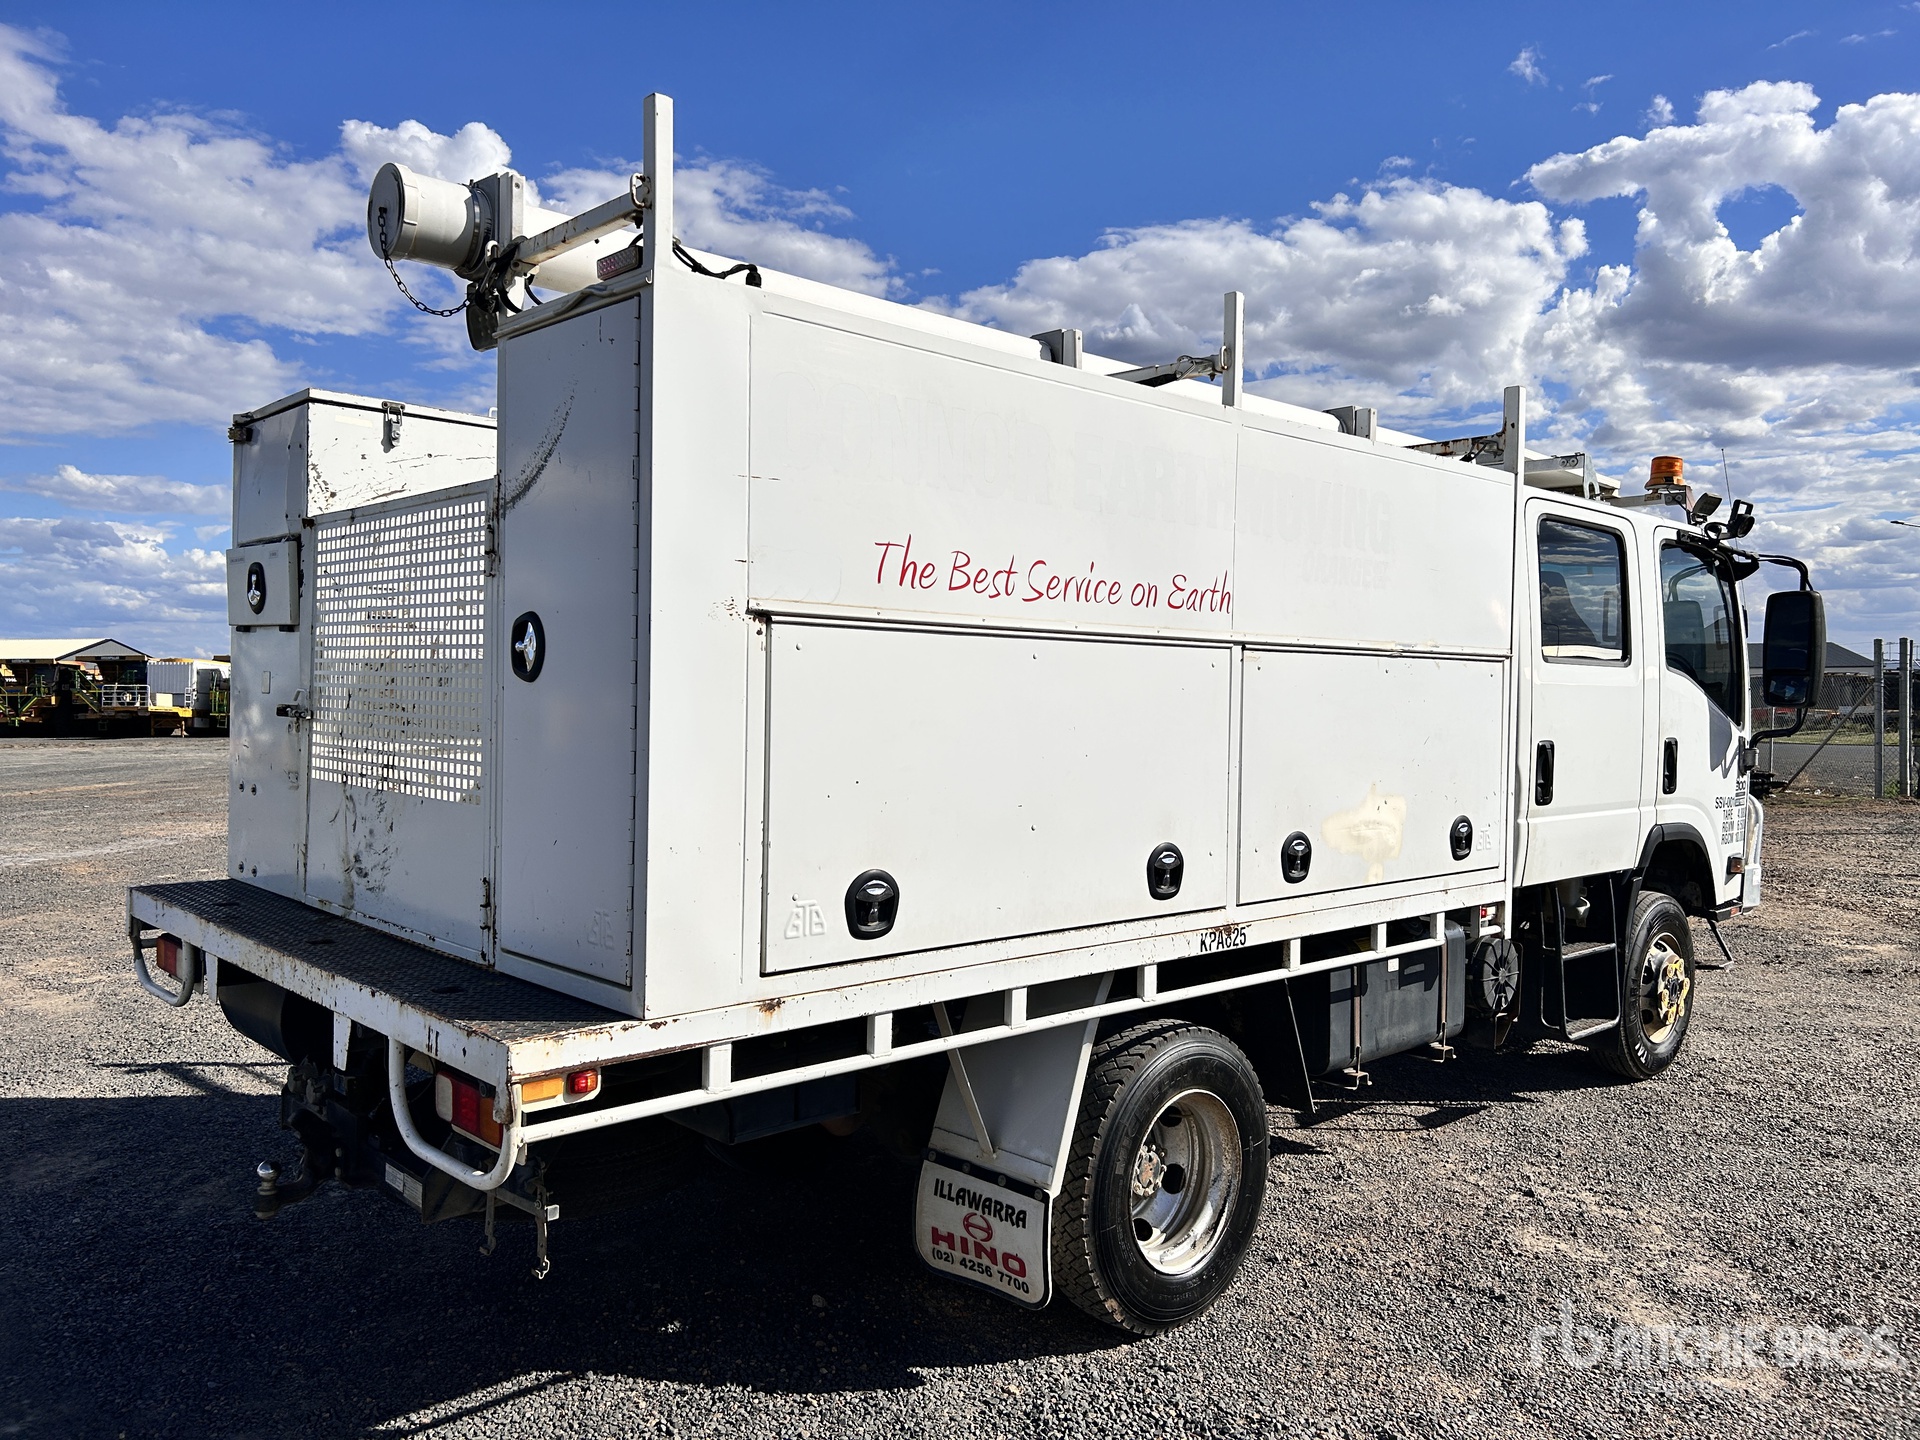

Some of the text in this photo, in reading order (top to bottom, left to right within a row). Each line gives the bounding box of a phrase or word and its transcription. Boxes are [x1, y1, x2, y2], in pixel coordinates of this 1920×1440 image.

[875, 534, 1231, 614] The Best Service on Earth
[1200, 926, 1246, 952] KPA825
[933, 1177, 1028, 1229] ILLAWARRA
[931, 1226, 1027, 1278] HINO
[932, 1247, 1030, 1294] (02) 4256 7700
